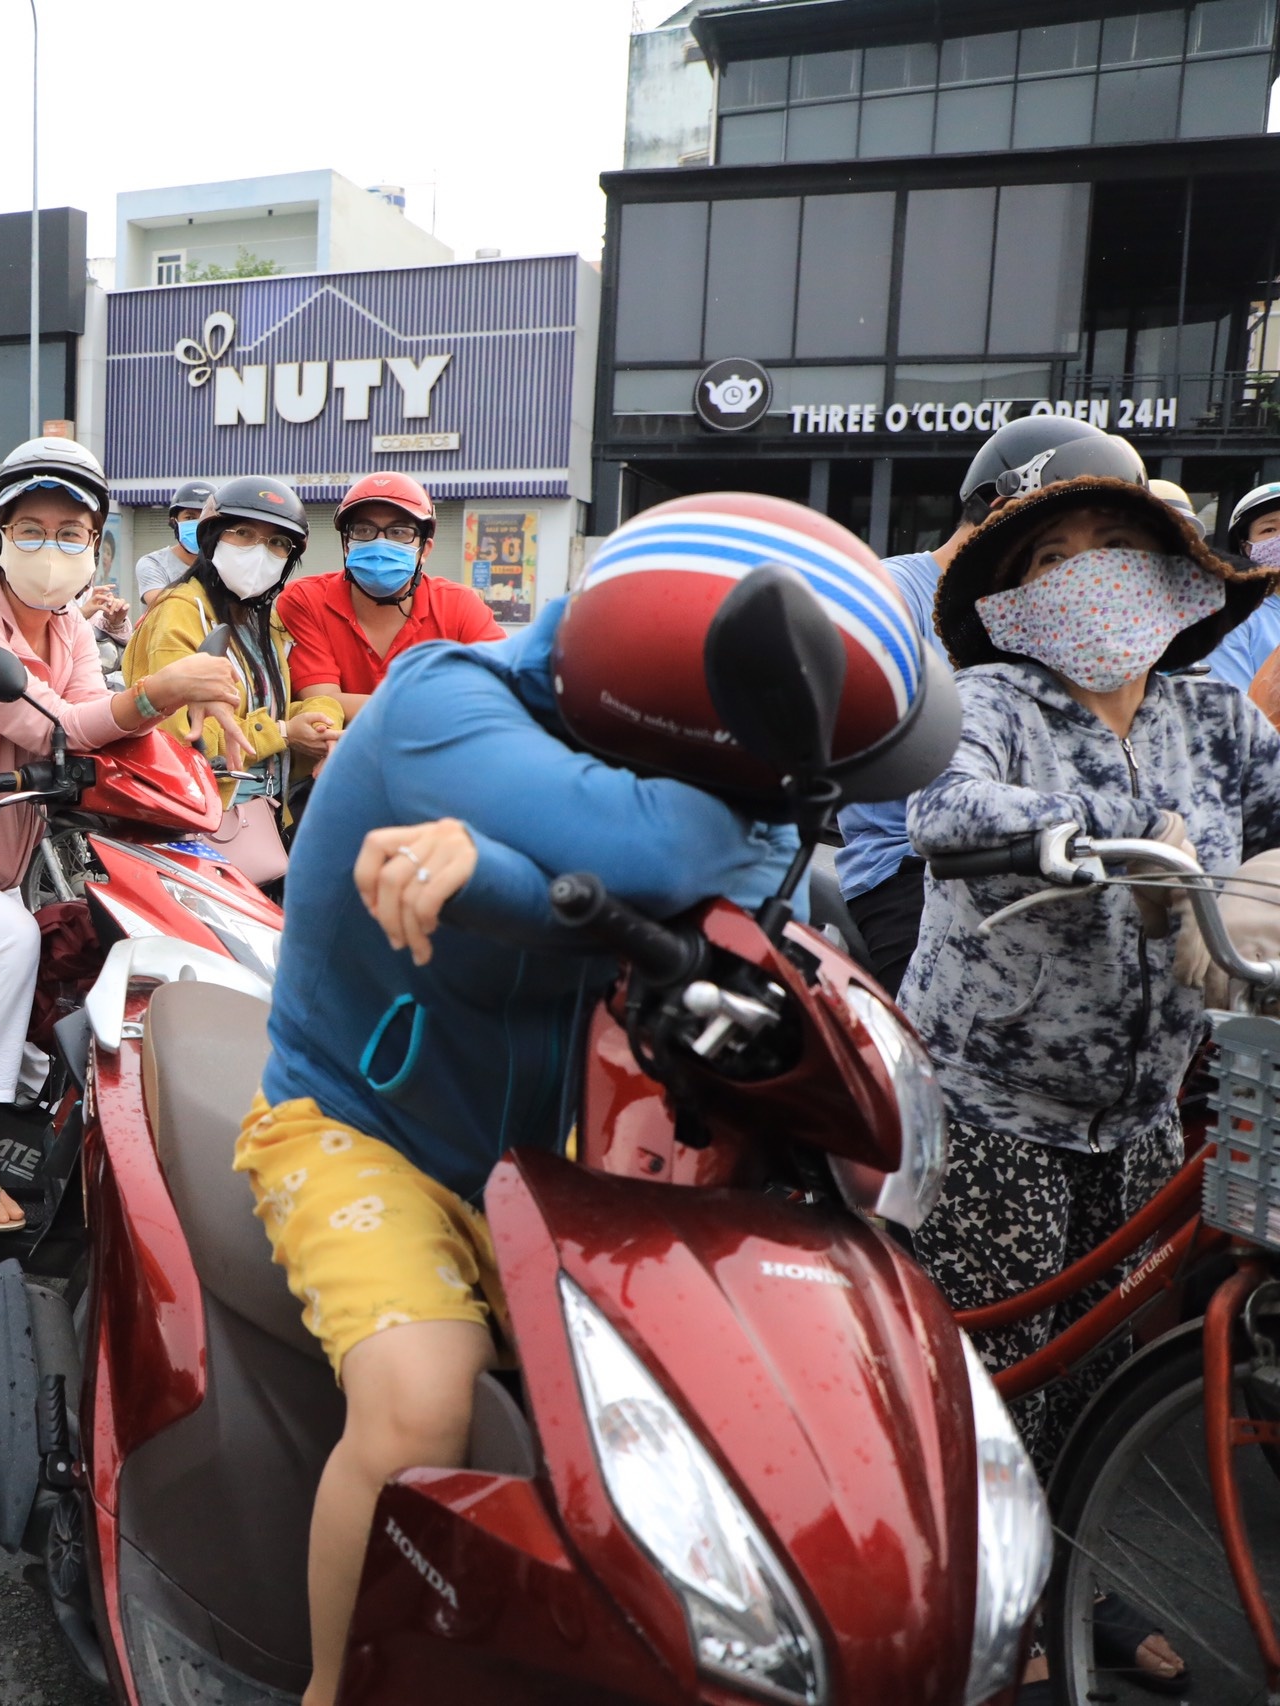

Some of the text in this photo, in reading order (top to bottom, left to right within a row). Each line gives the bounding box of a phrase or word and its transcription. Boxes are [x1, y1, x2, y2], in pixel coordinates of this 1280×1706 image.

[214, 354, 454, 426] NUTY
[790, 404, 876, 433] THREE
[885, 401, 1014, 433] O'CLOCK
[1117, 397, 1178, 429] 24H
[380, 435, 450, 449] COSMETICS
[296, 475, 324, 485] SINCE
[760, 1260, 854, 1289] HONDA
[1119, 1242, 1174, 1299] Marukin
[385, 1516, 458, 1610] HONDA
